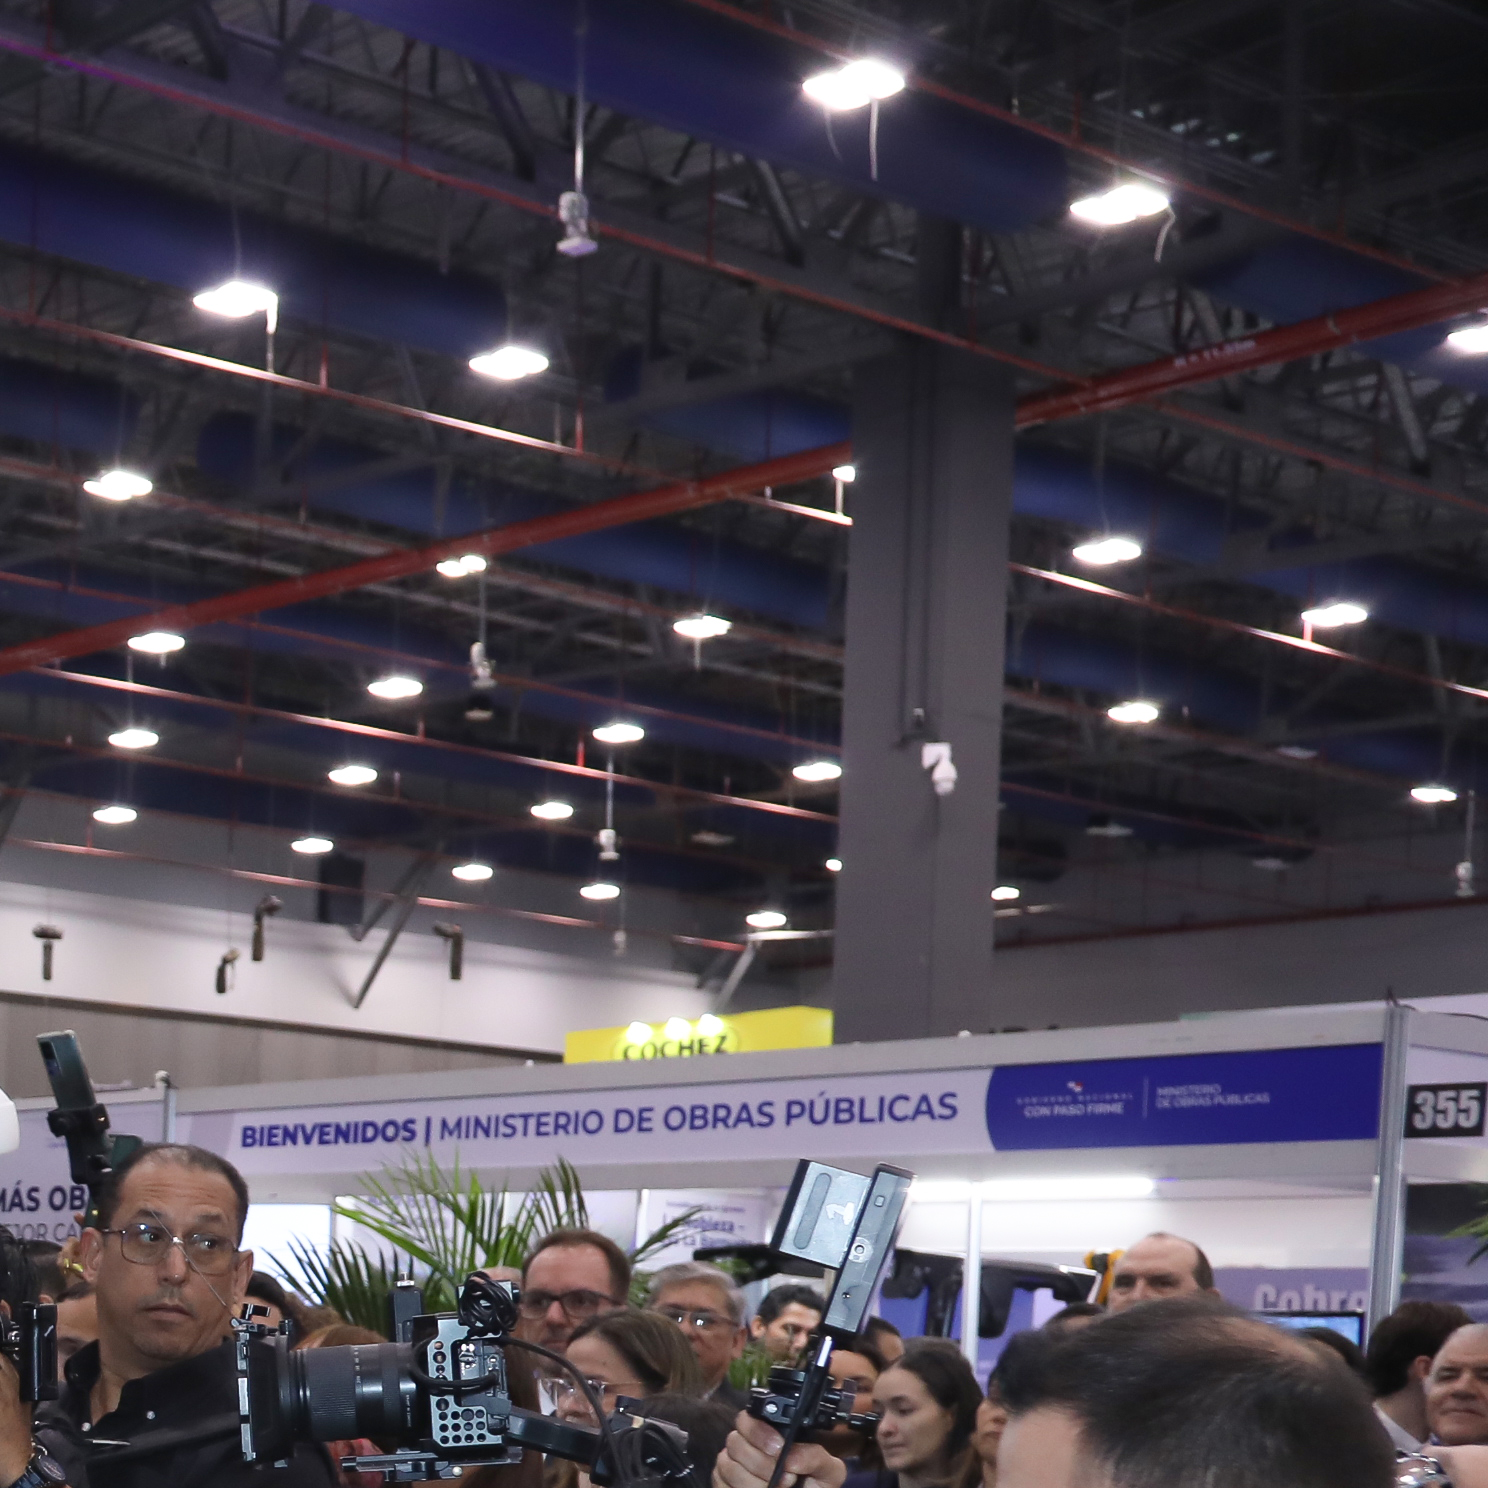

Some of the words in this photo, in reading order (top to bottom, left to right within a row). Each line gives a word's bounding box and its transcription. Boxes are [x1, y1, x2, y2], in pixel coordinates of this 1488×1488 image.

[240, 1117, 417, 1148] BIENVENIDOS
[439, 1109, 605, 1140] MINISTERIO
[613, 1106, 654, 1133] DE
[662, 1101, 776, 1131] OBRAS
[785, 1090, 959, 1127] PÚBLICAS
[1411, 1088, 1482, 1130] 355
